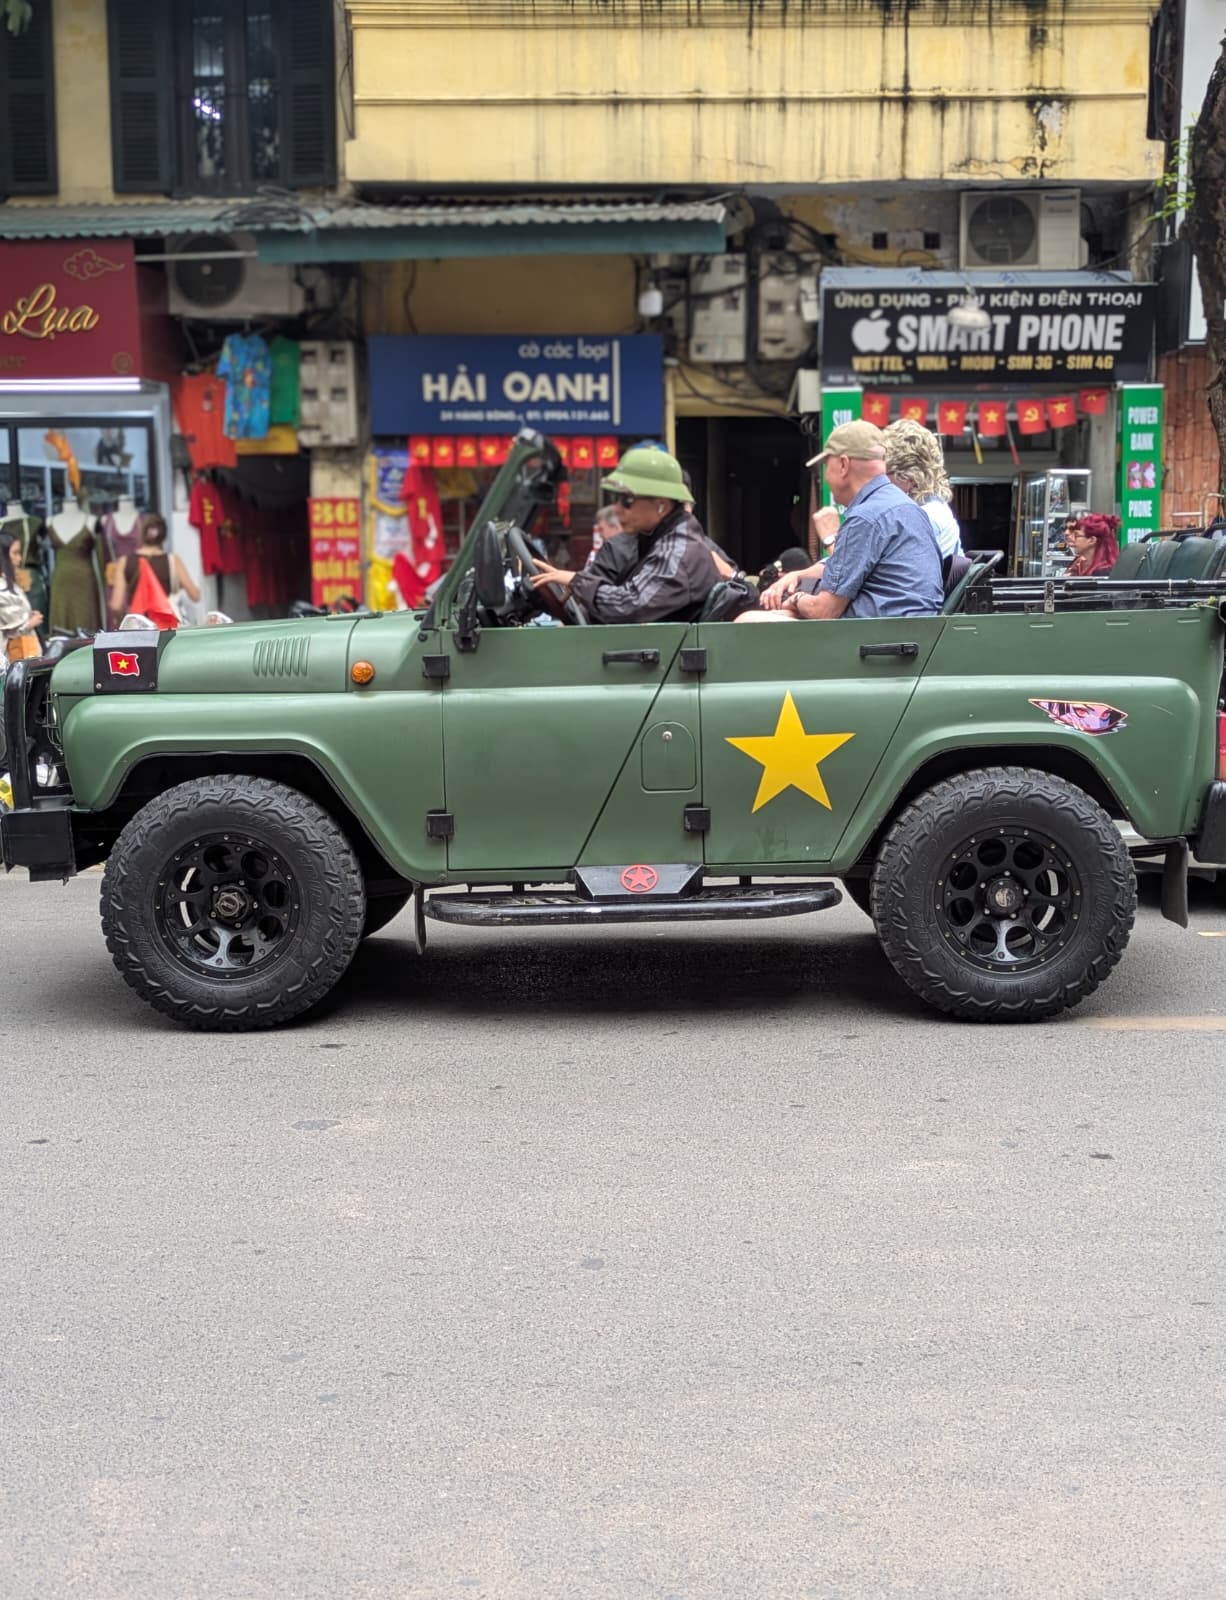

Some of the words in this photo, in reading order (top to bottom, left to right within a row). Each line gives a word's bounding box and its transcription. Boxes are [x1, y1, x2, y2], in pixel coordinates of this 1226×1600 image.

[879, 293, 931, 310] DỤNG
[989, 290, 1034, 308] KIỆN
[1038, 289, 1082, 308] ĐIỆN
[1086, 292, 1143, 308] THOẠI
[896, 314, 1011, 352] SMART
[1017, 314, 1126, 351] PHONE
[1006, 355, 1033, 371] SIM
[1034, 355, 1053, 370] 3G
[1066, 354, 1094, 370] SIM
[1095, 354, 1114, 370] 4G
[422, 364, 487, 402] HẢI
[502, 371, 610, 402] OANH
[1128, 406, 1158, 424] POWER
[1130, 432, 1154, 450] BANK
